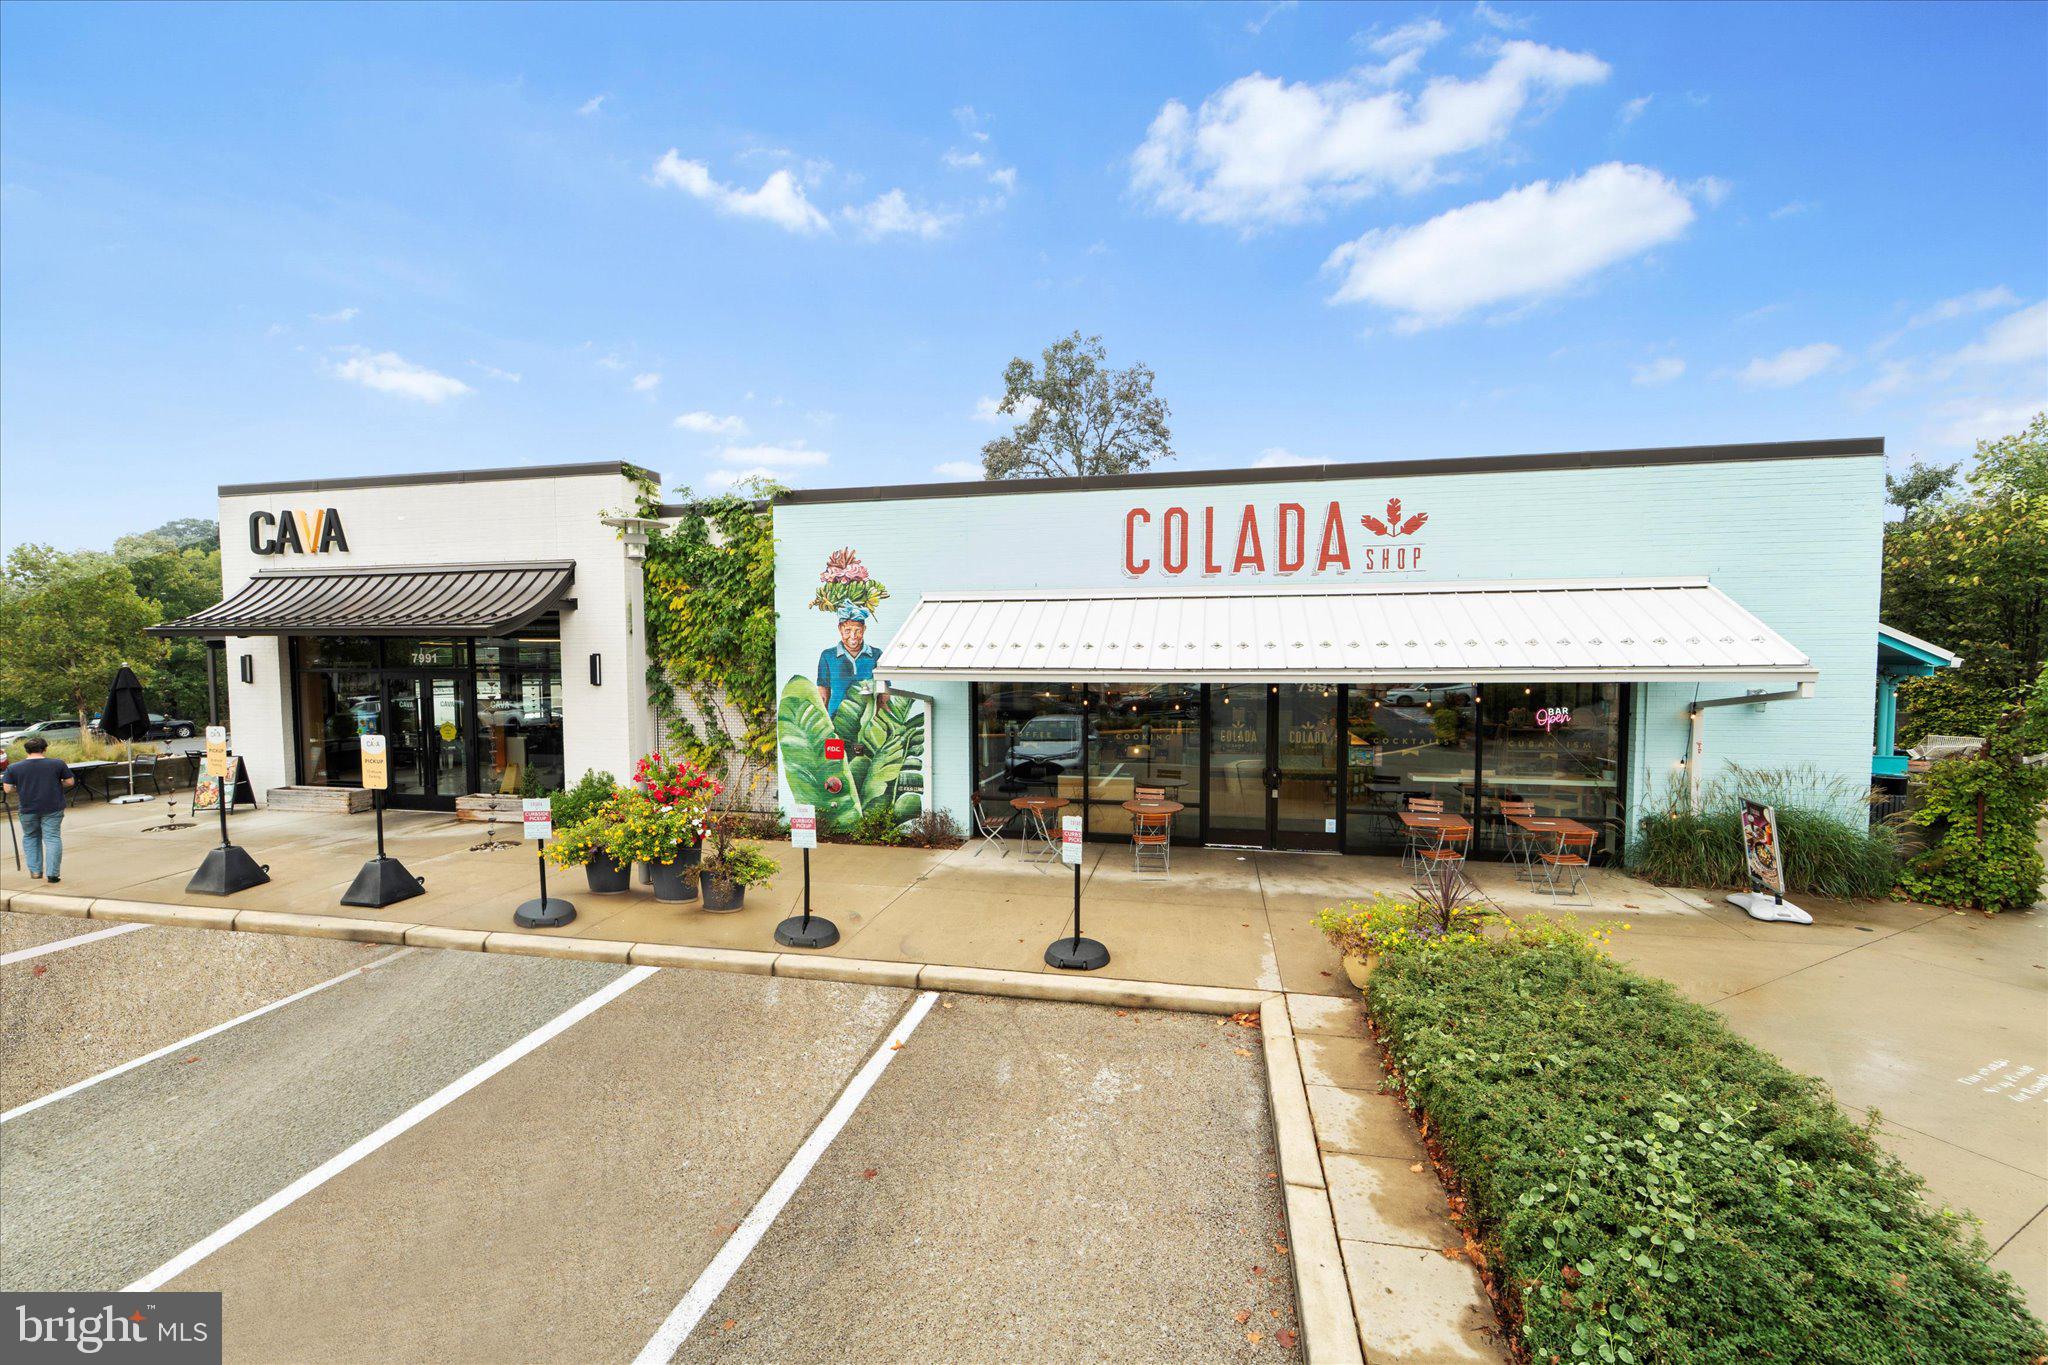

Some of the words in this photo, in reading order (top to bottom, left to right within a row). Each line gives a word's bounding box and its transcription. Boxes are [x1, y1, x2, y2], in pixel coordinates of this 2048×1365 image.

[249, 508, 349, 555] CAVA
[1122, 500, 1350, 578] COLADA
[1366, 547, 1421, 570] SHOP
[411, 653, 437, 663] 7991
[399, 700, 414, 708] CAVA
[440, 700, 455, 708] CAVA
[489, 699, 510, 709] CAVA
[1548, 707, 1569, 716] BAR
[1536, 708, 1571, 732] Open
[1115, 733, 1171, 741] COOKING
[1220, 730, 1257, 743] COLADA
[1289, 731, 1328, 744] COLADA
[1373, 737, 1449, 746] COCKTAILS
[1507, 740, 1556, 748] CUBAN
